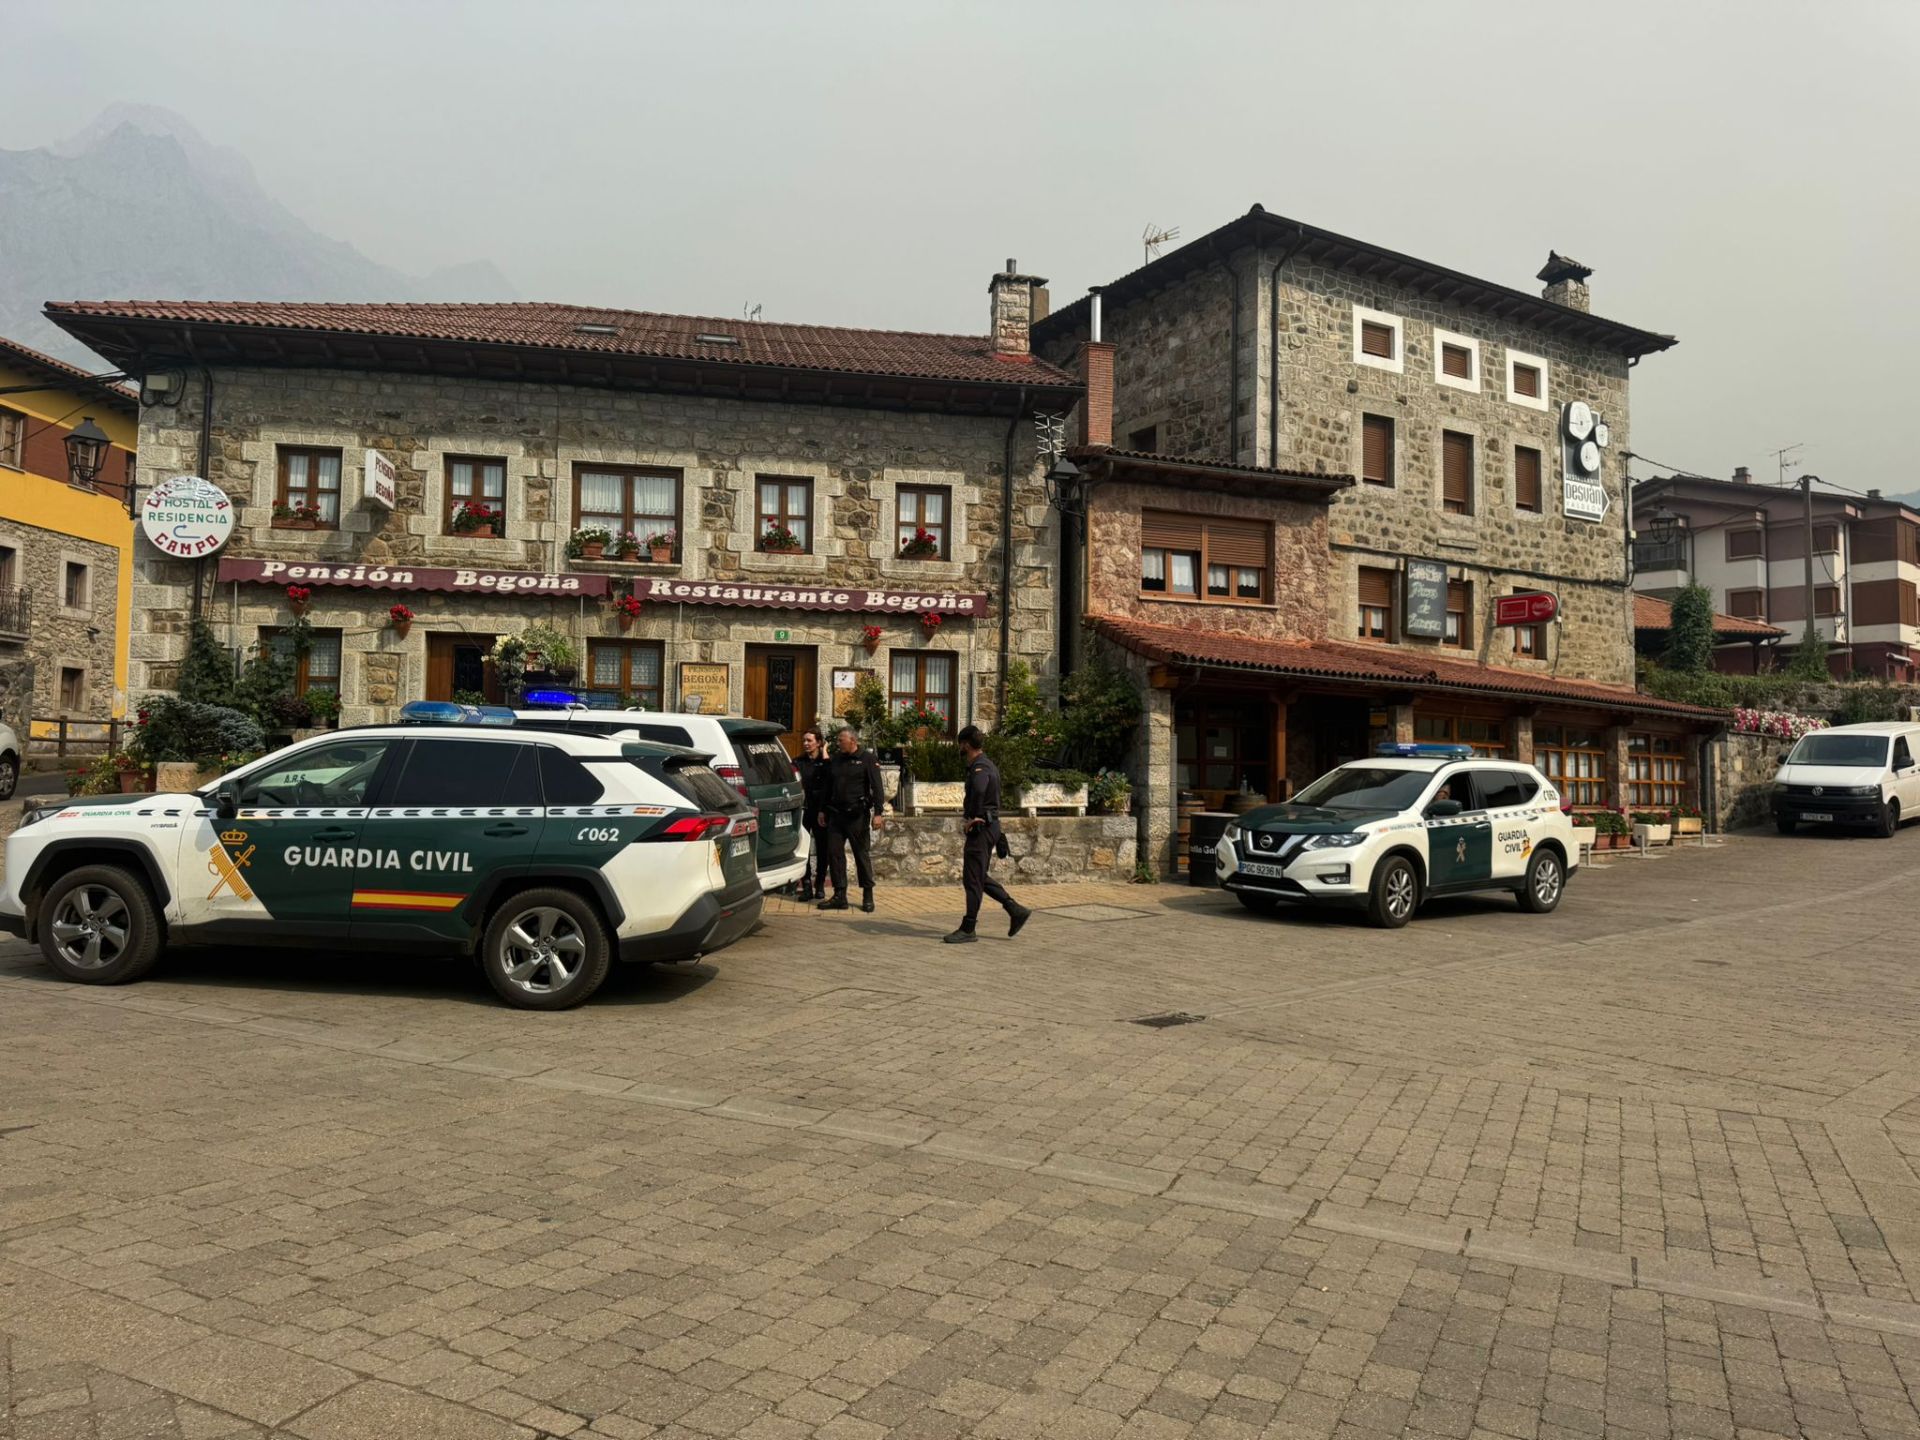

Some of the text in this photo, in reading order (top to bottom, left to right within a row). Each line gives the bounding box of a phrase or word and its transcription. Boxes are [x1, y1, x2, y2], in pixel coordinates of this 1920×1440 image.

[164, 499, 213, 509] HOSTAL
[148, 511, 228, 524] RESIDENCIA
[154, 532, 219, 555] CAMPO
[261, 561, 580, 591] Pensión Begoña
[648, 580, 974, 611] Restaurante Begoña
[683, 673, 726, 684] BEGOÑA
[588, 827, 620, 842] 062
[1498, 829, 1528, 843] GUARDIA
[1504, 841, 1522, 853] CIVIL
[283, 845, 474, 872] GUARDIA CIVIL
